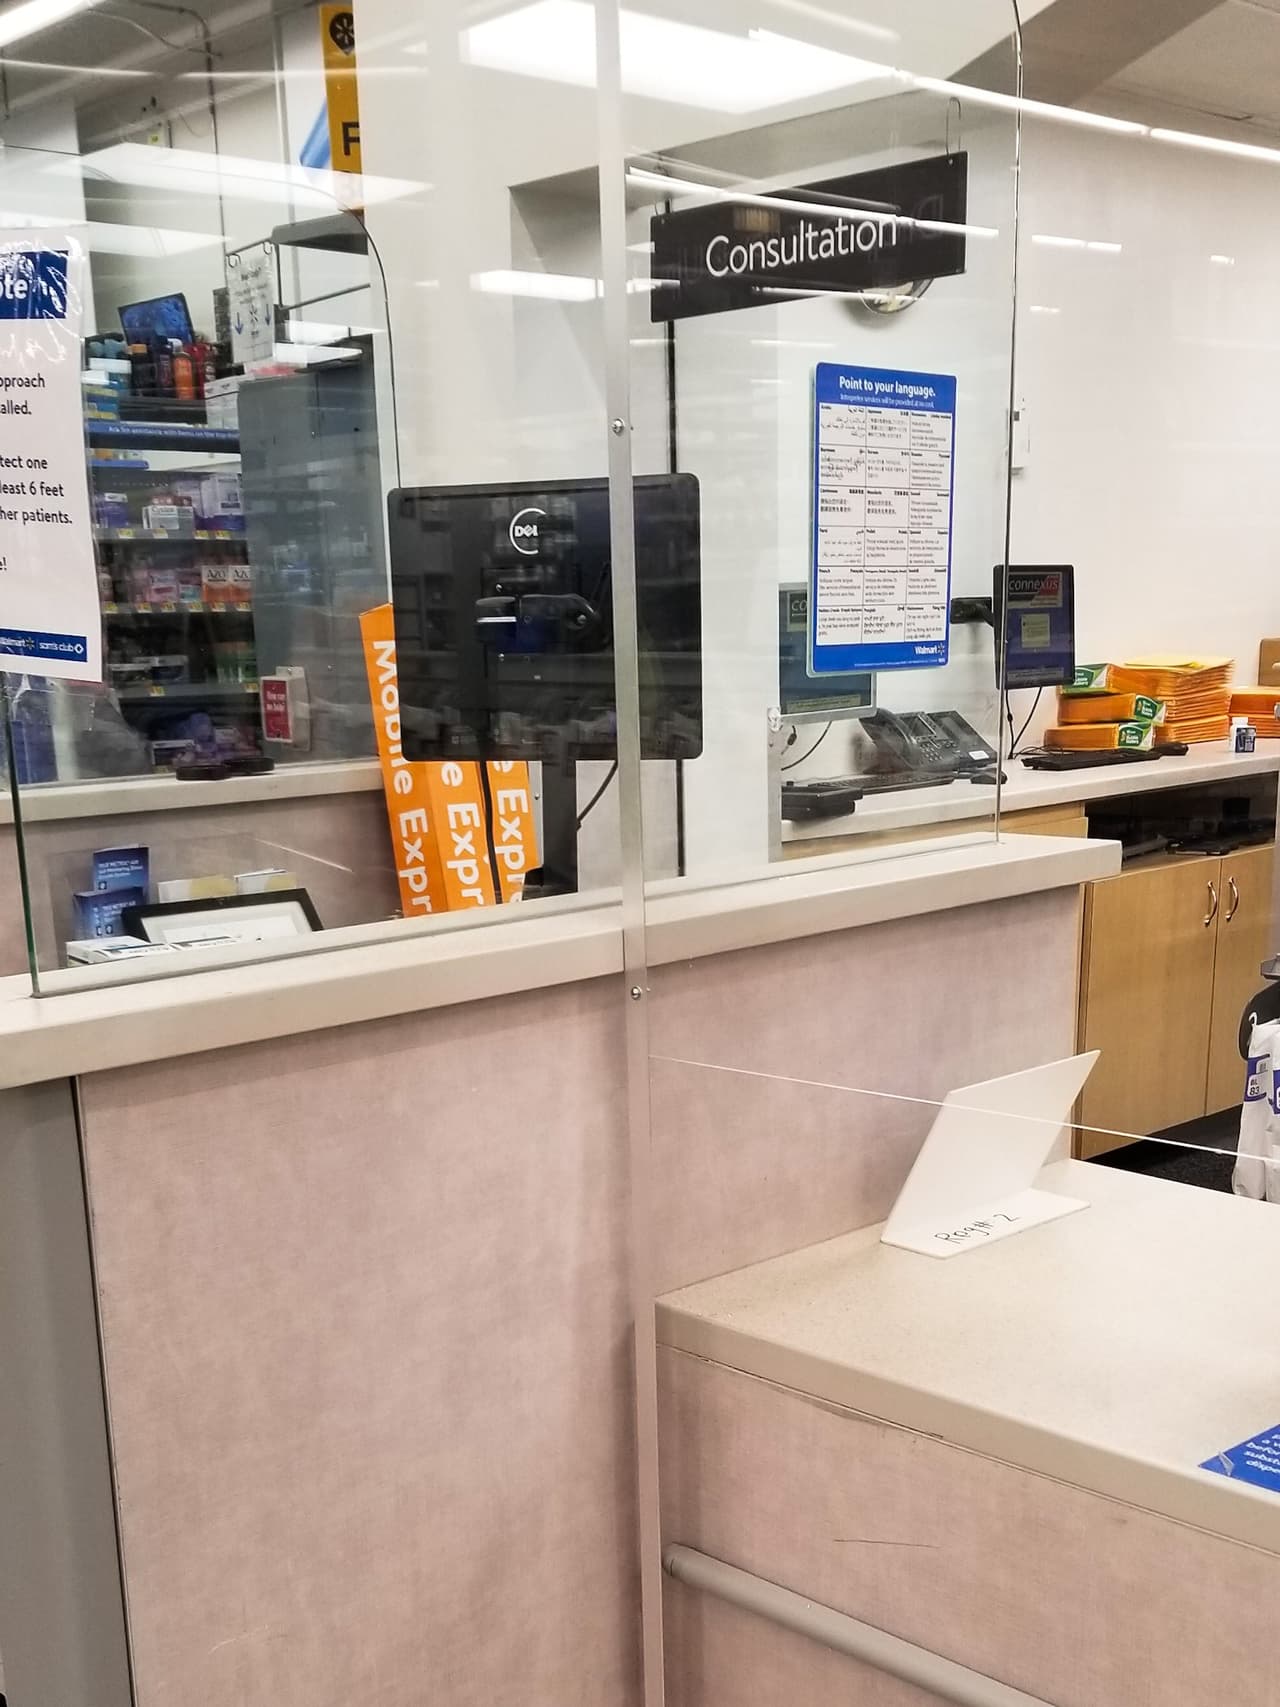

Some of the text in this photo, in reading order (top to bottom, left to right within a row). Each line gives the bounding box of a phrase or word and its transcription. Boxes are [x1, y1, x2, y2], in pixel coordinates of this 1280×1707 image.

[705, 216, 897, 277] Consultation
[839, 376, 937, 399] Point to your language.
[26, 459, 48, 469] one
[29, 481, 37, 495] 6
[40, 481, 65, 497] feet
[22, 508, 73, 525] patients.
[1008, 579, 1059, 592] connexus
[914, 645, 938, 656] Walmart
[1249, 1086, 1260, 1096] 83
